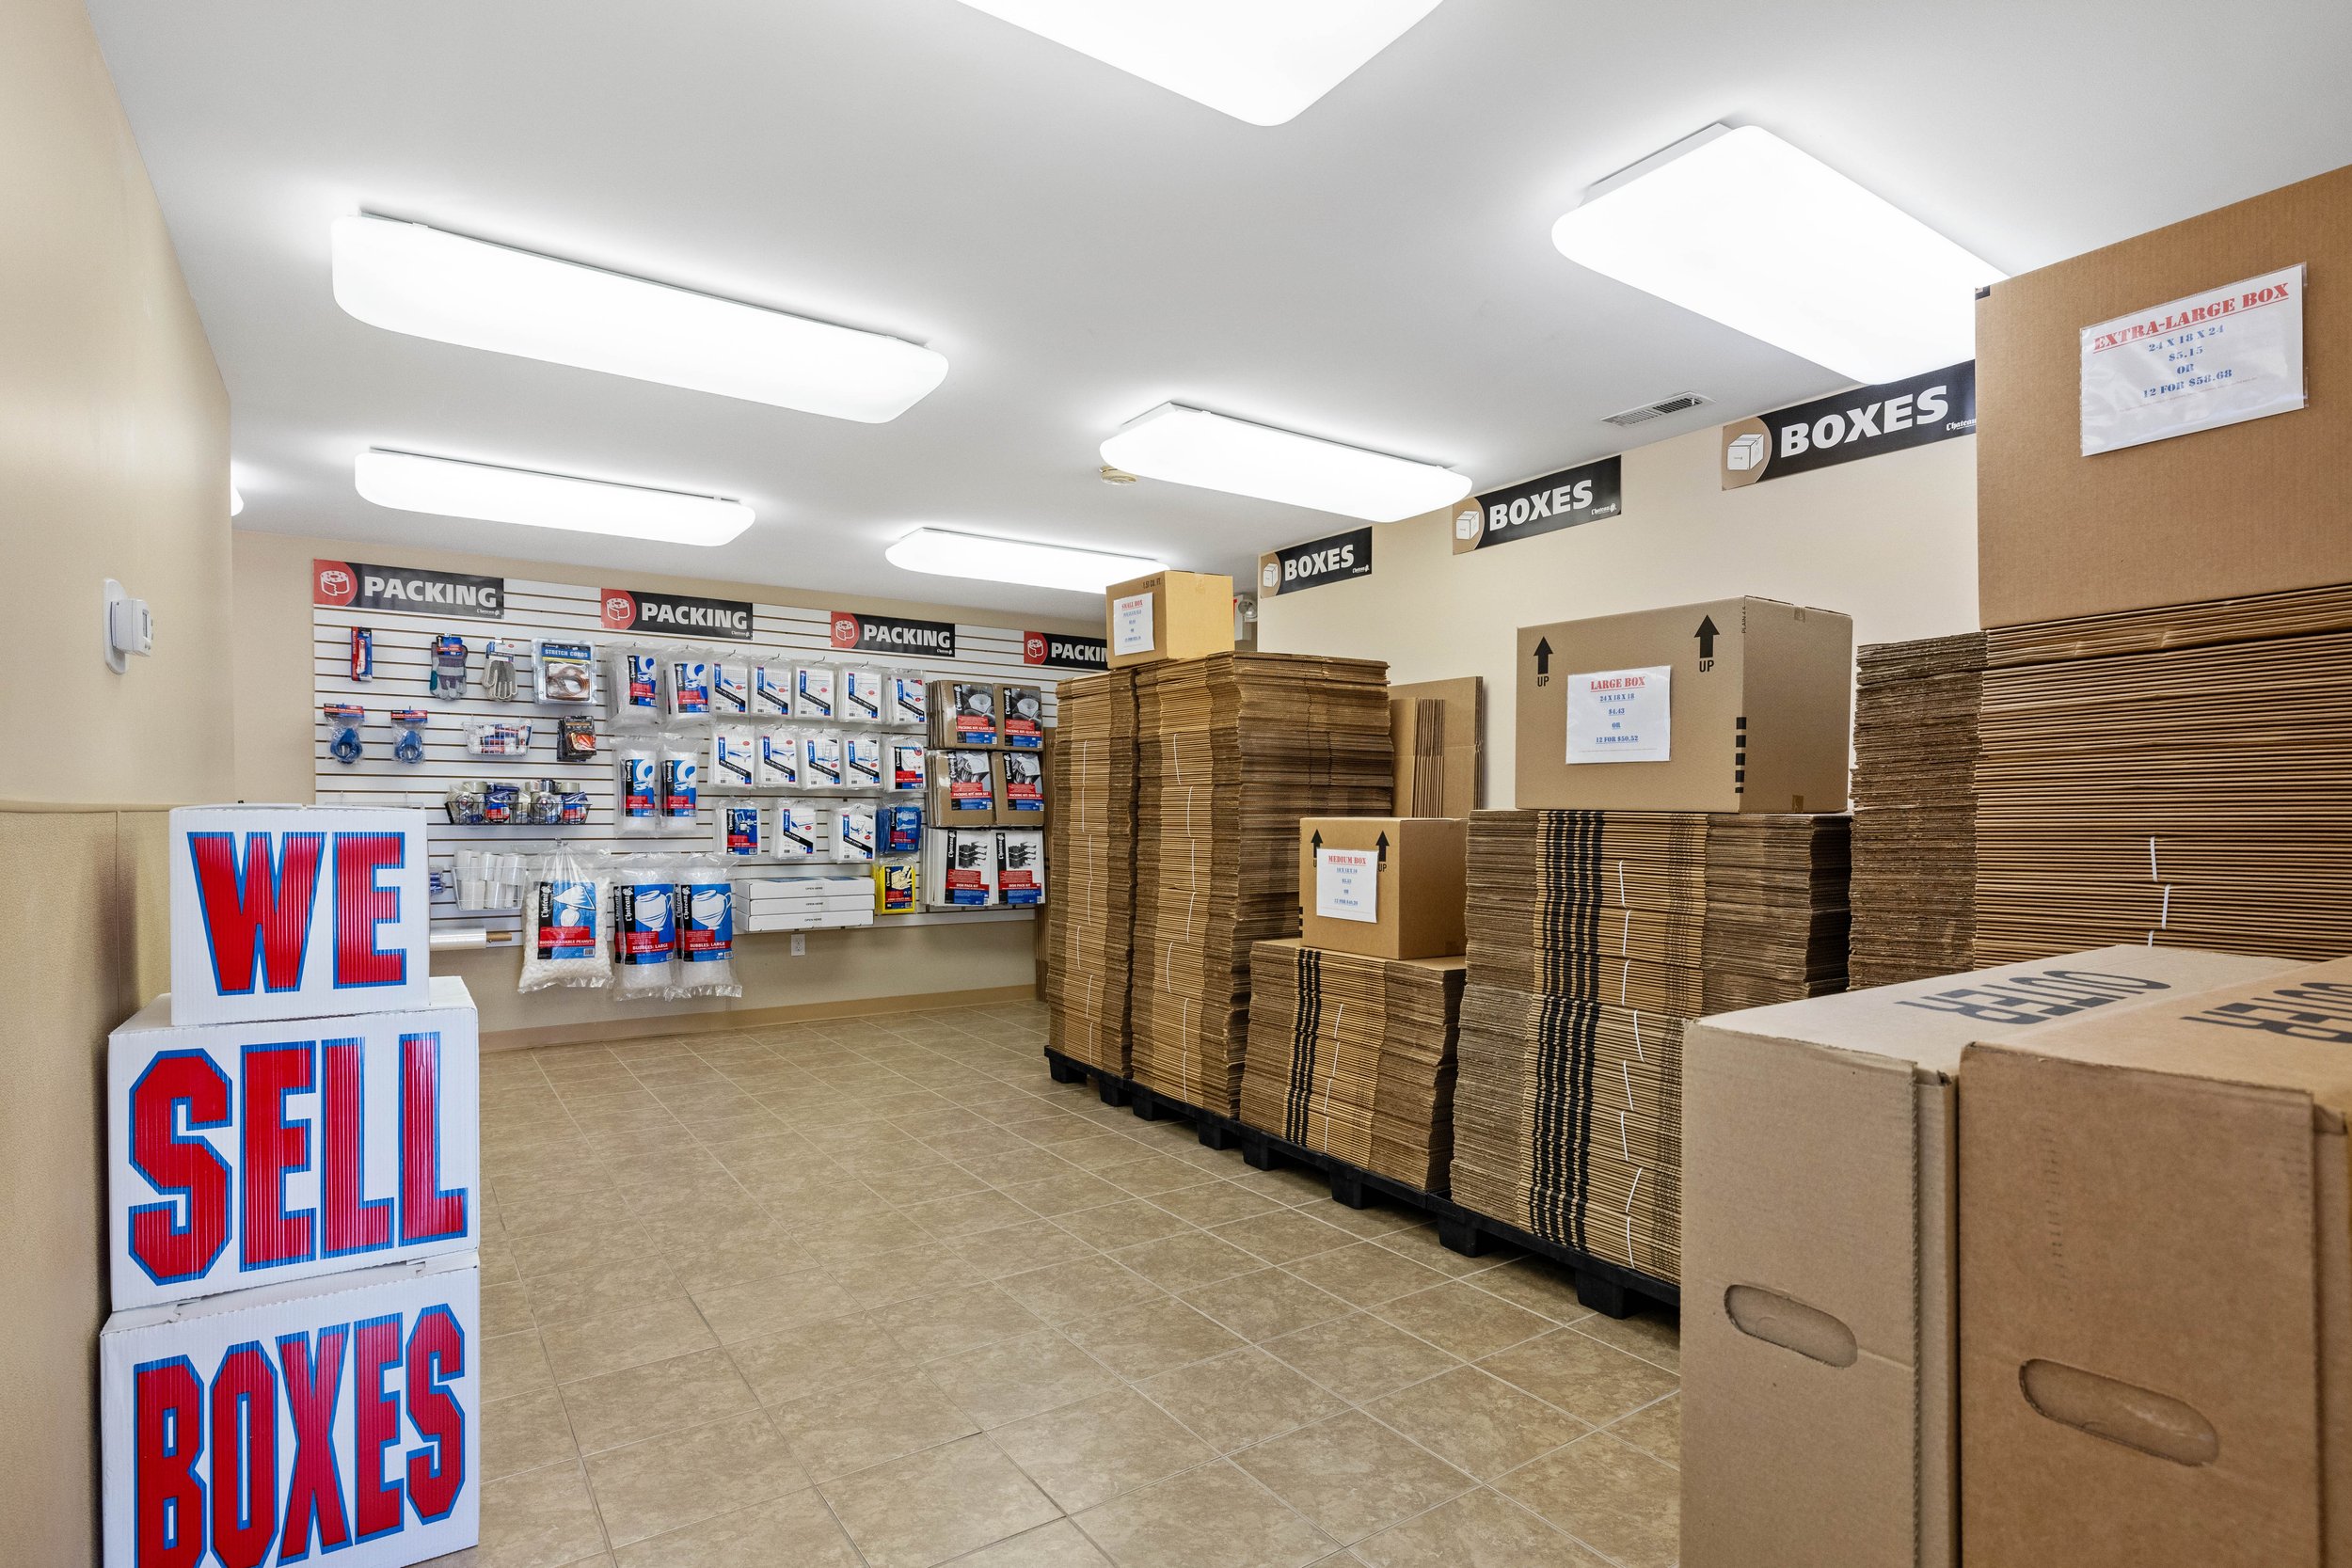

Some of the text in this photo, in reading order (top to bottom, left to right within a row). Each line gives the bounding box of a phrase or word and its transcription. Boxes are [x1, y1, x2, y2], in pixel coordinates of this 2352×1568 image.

[2092, 282, 2289, 352] EXTRA-LARGE BOX
[2148, 324, 2225, 352] 24 X 18 X 24
[2169, 345, 2204, 362] $5.15
[2176, 363, 2195, 375] OR
[2143, 369, 2233, 399] 12 FOR $58.68
[1780, 385, 1949, 459] BOXES
[1488, 479, 1593, 531] BOXES
[1284, 544, 1354, 581] BOXES
[364, 575, 497, 609] PACKING
[642, 603, 748, 630] PACKING
[864, 624, 950, 648] PACKING
[1051, 642, 1107, 662] PACKIN
[1699, 660, 1714, 673] UP
[1537, 676, 1549, 687] UP
[1590, 676, 1645, 690] LARGE BOX
[1328, 855, 1352, 864] MEDIUM
[1378, 863, 1387, 872] UP
[186, 832, 407, 997] WE
[1894, 970, 2171, 1025] OUTER
[128, 1031, 469, 1287] SELL
[134, 1302, 466, 1568] BOXES
